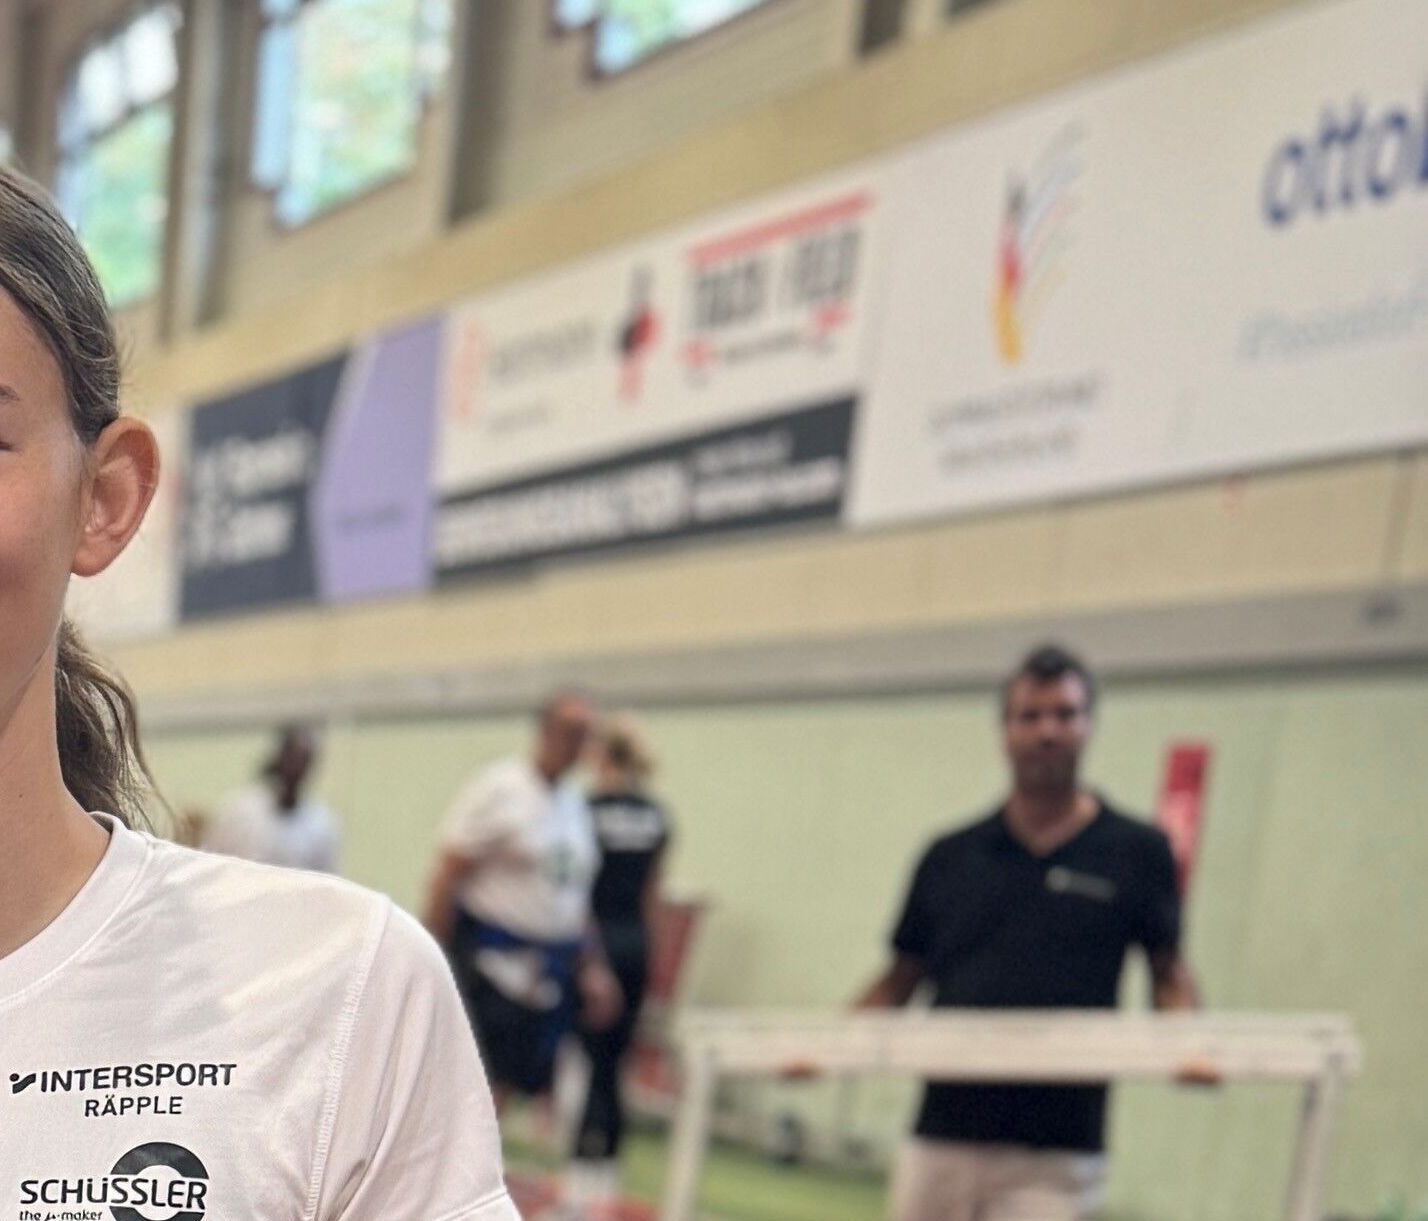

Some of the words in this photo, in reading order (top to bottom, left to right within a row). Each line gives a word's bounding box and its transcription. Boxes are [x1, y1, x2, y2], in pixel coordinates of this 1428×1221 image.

[41, 1063, 237, 1092] INTERSPORT
[85, 1095, 183, 1117] RÄPPLE
[20, 1178, 207, 1210] SCHÜSSLER
[19, 1210, 41, 1221] the
